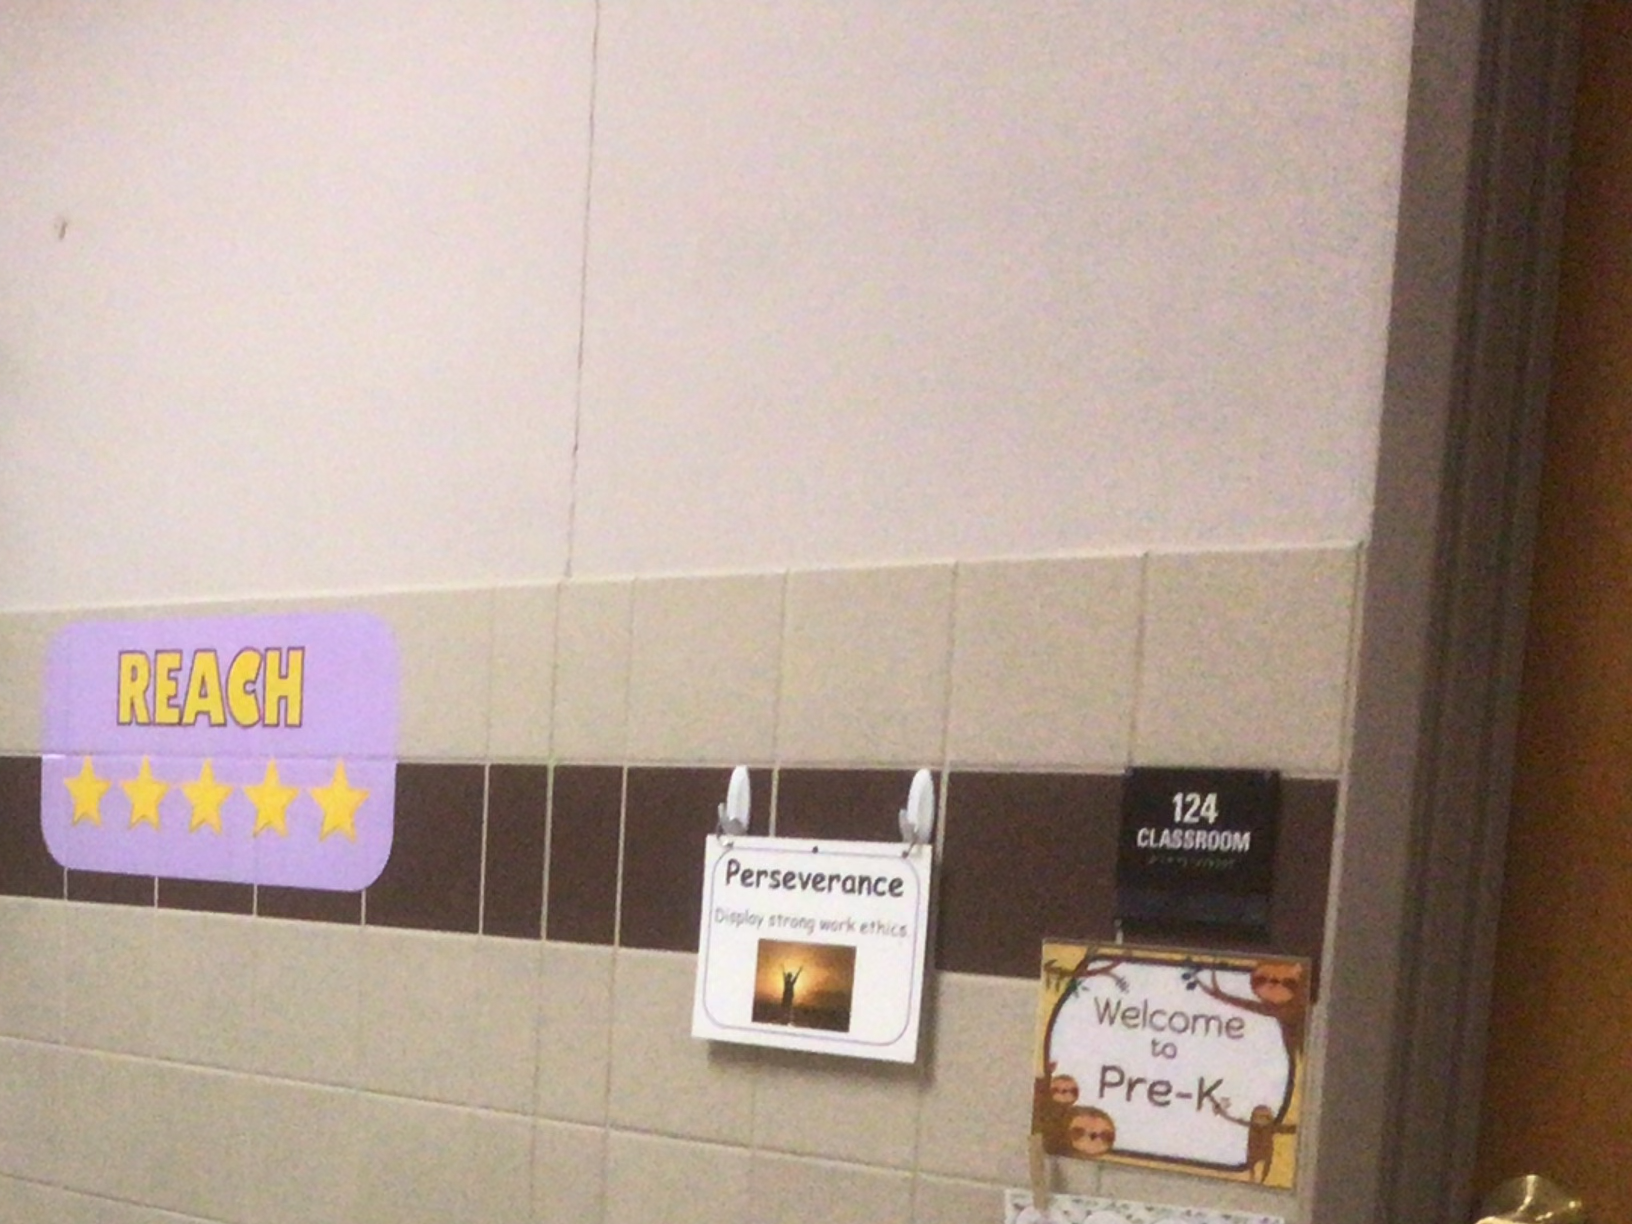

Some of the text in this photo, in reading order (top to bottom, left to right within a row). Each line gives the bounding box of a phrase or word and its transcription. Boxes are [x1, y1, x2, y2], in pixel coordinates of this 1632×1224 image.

[117, 646, 305, 729] REACH
[1172, 792, 1218, 824] 124
[1137, 827, 1251, 852] CLASSROOM
[725, 858, 905, 898] Perseverance
[714, 907, 908, 937] Display strong work ethics
[1094, 996, 1245, 1039] Welcome
[1151, 1037, 1178, 1060] to
[1098, 1064, 1224, 1111] Pre-K
